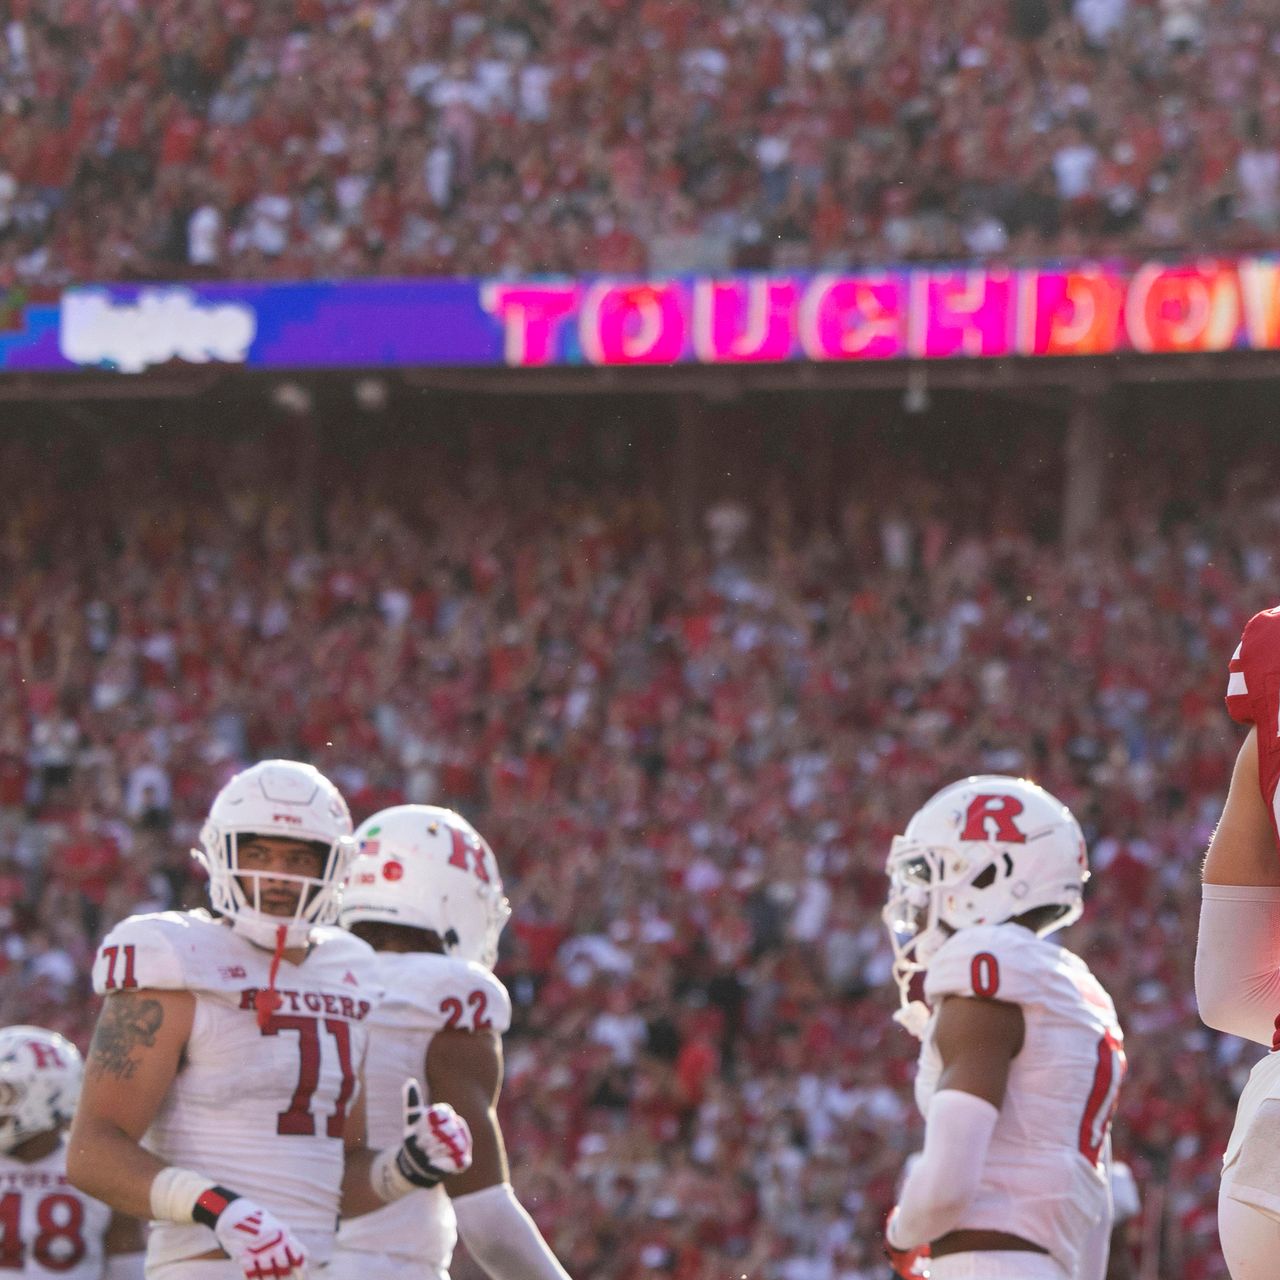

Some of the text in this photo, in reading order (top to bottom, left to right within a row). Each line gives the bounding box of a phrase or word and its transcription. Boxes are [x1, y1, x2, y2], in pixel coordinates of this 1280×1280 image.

[960, 794, 1027, 843] R
[102, 945, 138, 990] 71
[971, 953, 999, 996] 0
[439, 989, 493, 1031] 22
[261, 1014, 357, 1138] 71
